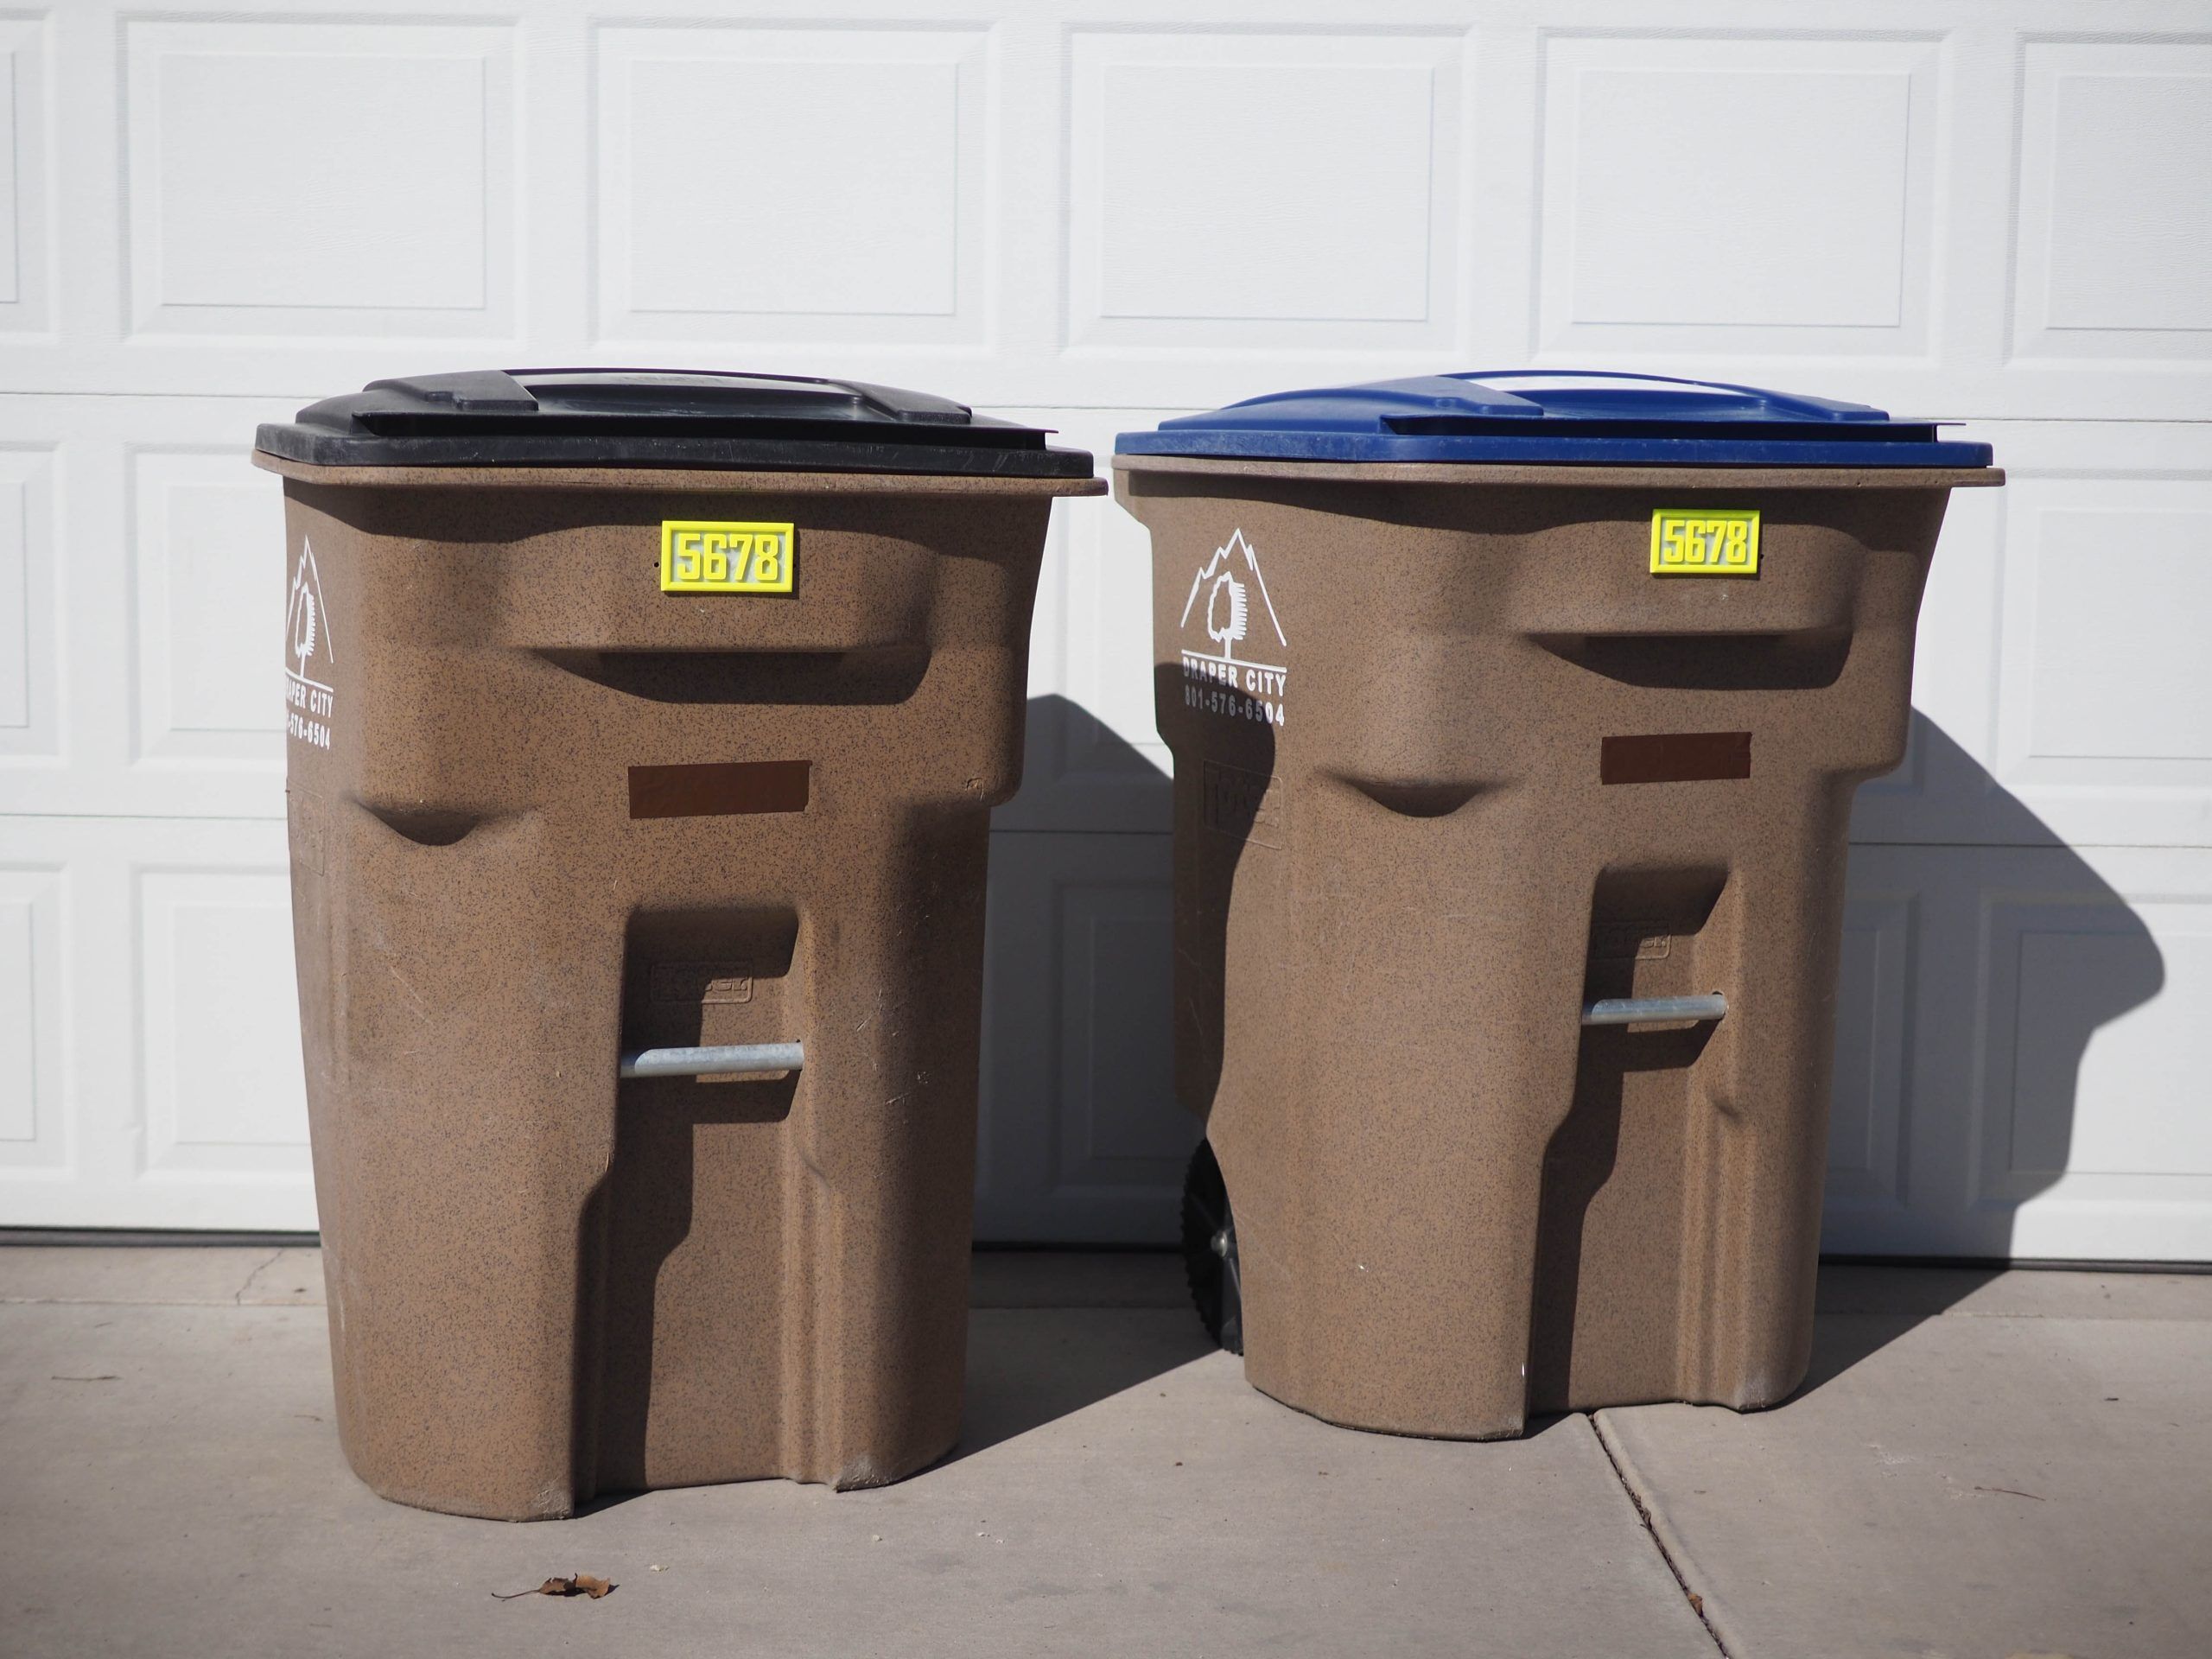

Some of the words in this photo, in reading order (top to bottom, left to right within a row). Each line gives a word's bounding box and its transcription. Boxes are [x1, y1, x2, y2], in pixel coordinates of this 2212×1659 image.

[677, 533, 779, 581] 5678
[1663, 520, 1748, 563] 5678
[1183, 657, 1238, 688] DRAPER
[1246, 669, 1287, 696] CITY
[310, 690, 334, 718] CITY
[1185, 684, 1285, 726] 801-576-6504
